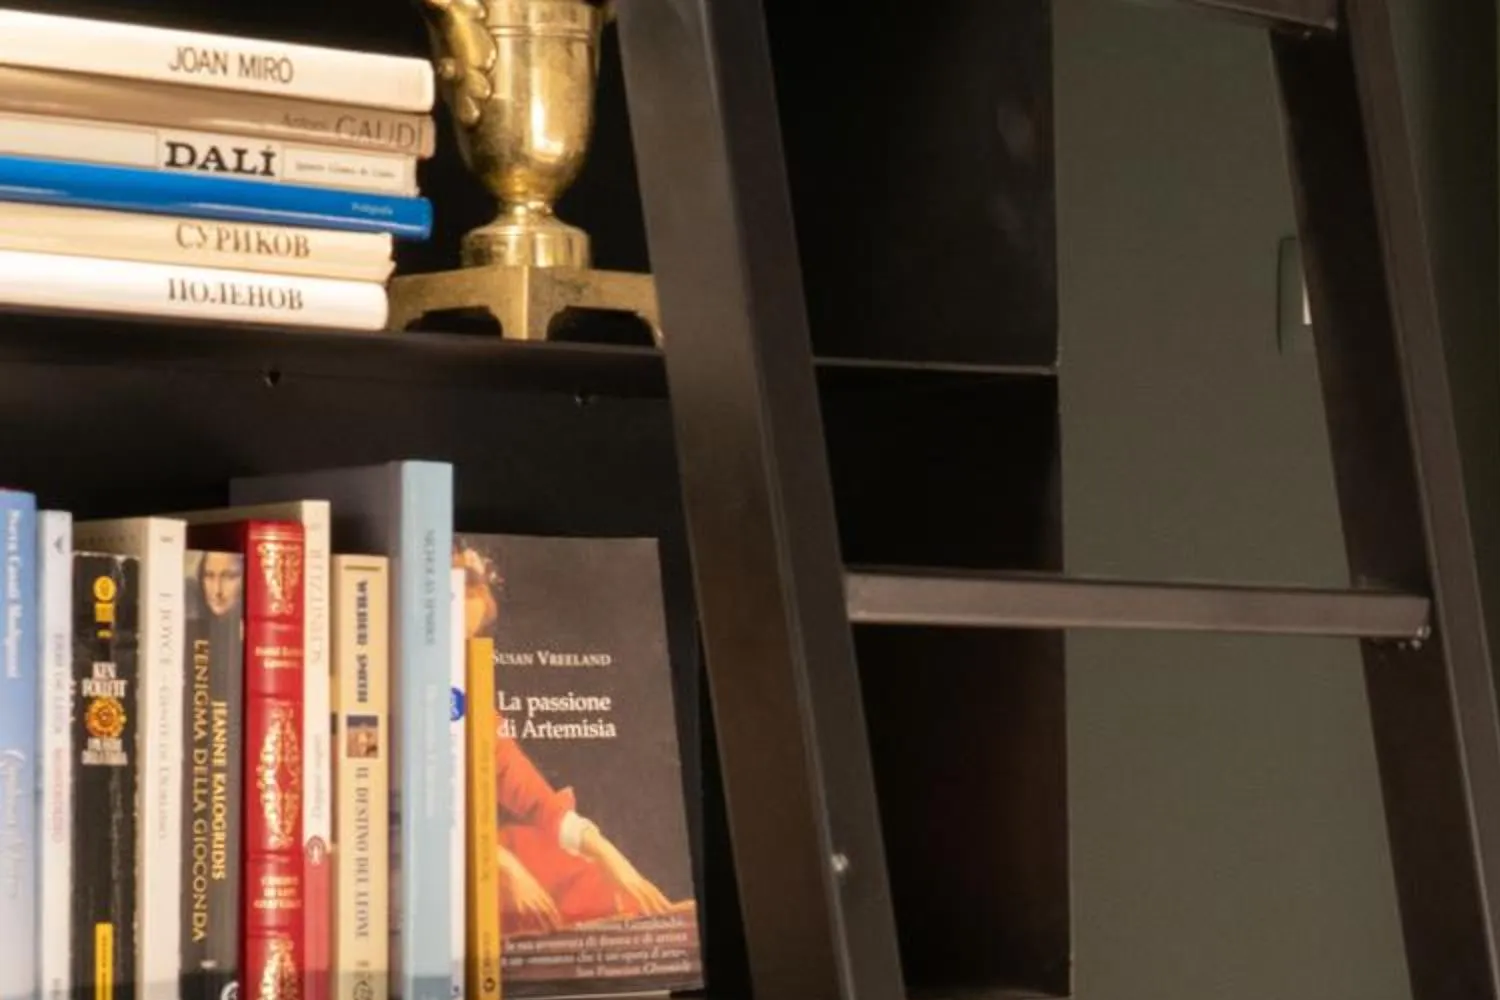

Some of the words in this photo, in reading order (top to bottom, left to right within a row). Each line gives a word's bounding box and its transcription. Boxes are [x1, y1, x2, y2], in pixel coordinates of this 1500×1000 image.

[168, 45, 230, 77] JOAN
[164, 140, 278, 177] DALÍ
[176, 222, 311, 259] СУРИКОВ
[168, 277, 304, 312] ПОЛЕНОВ
[193, 638, 210, 741] L'ENIGMA
[498, 690, 521, 711] La
[527, 692, 612, 717] passione
[211, 700, 228, 767] JEANNE
[496, 719, 517, 737] di
[522, 719, 617, 739] Artemisia
[192, 747, 210, 813] DELLA
[211, 772, 228, 881] KALOGRIDIS
[354, 787, 370, 852] DESTINO
[191, 818, 209, 942] GIOCONDA
[354, 857, 370, 884] DEL
